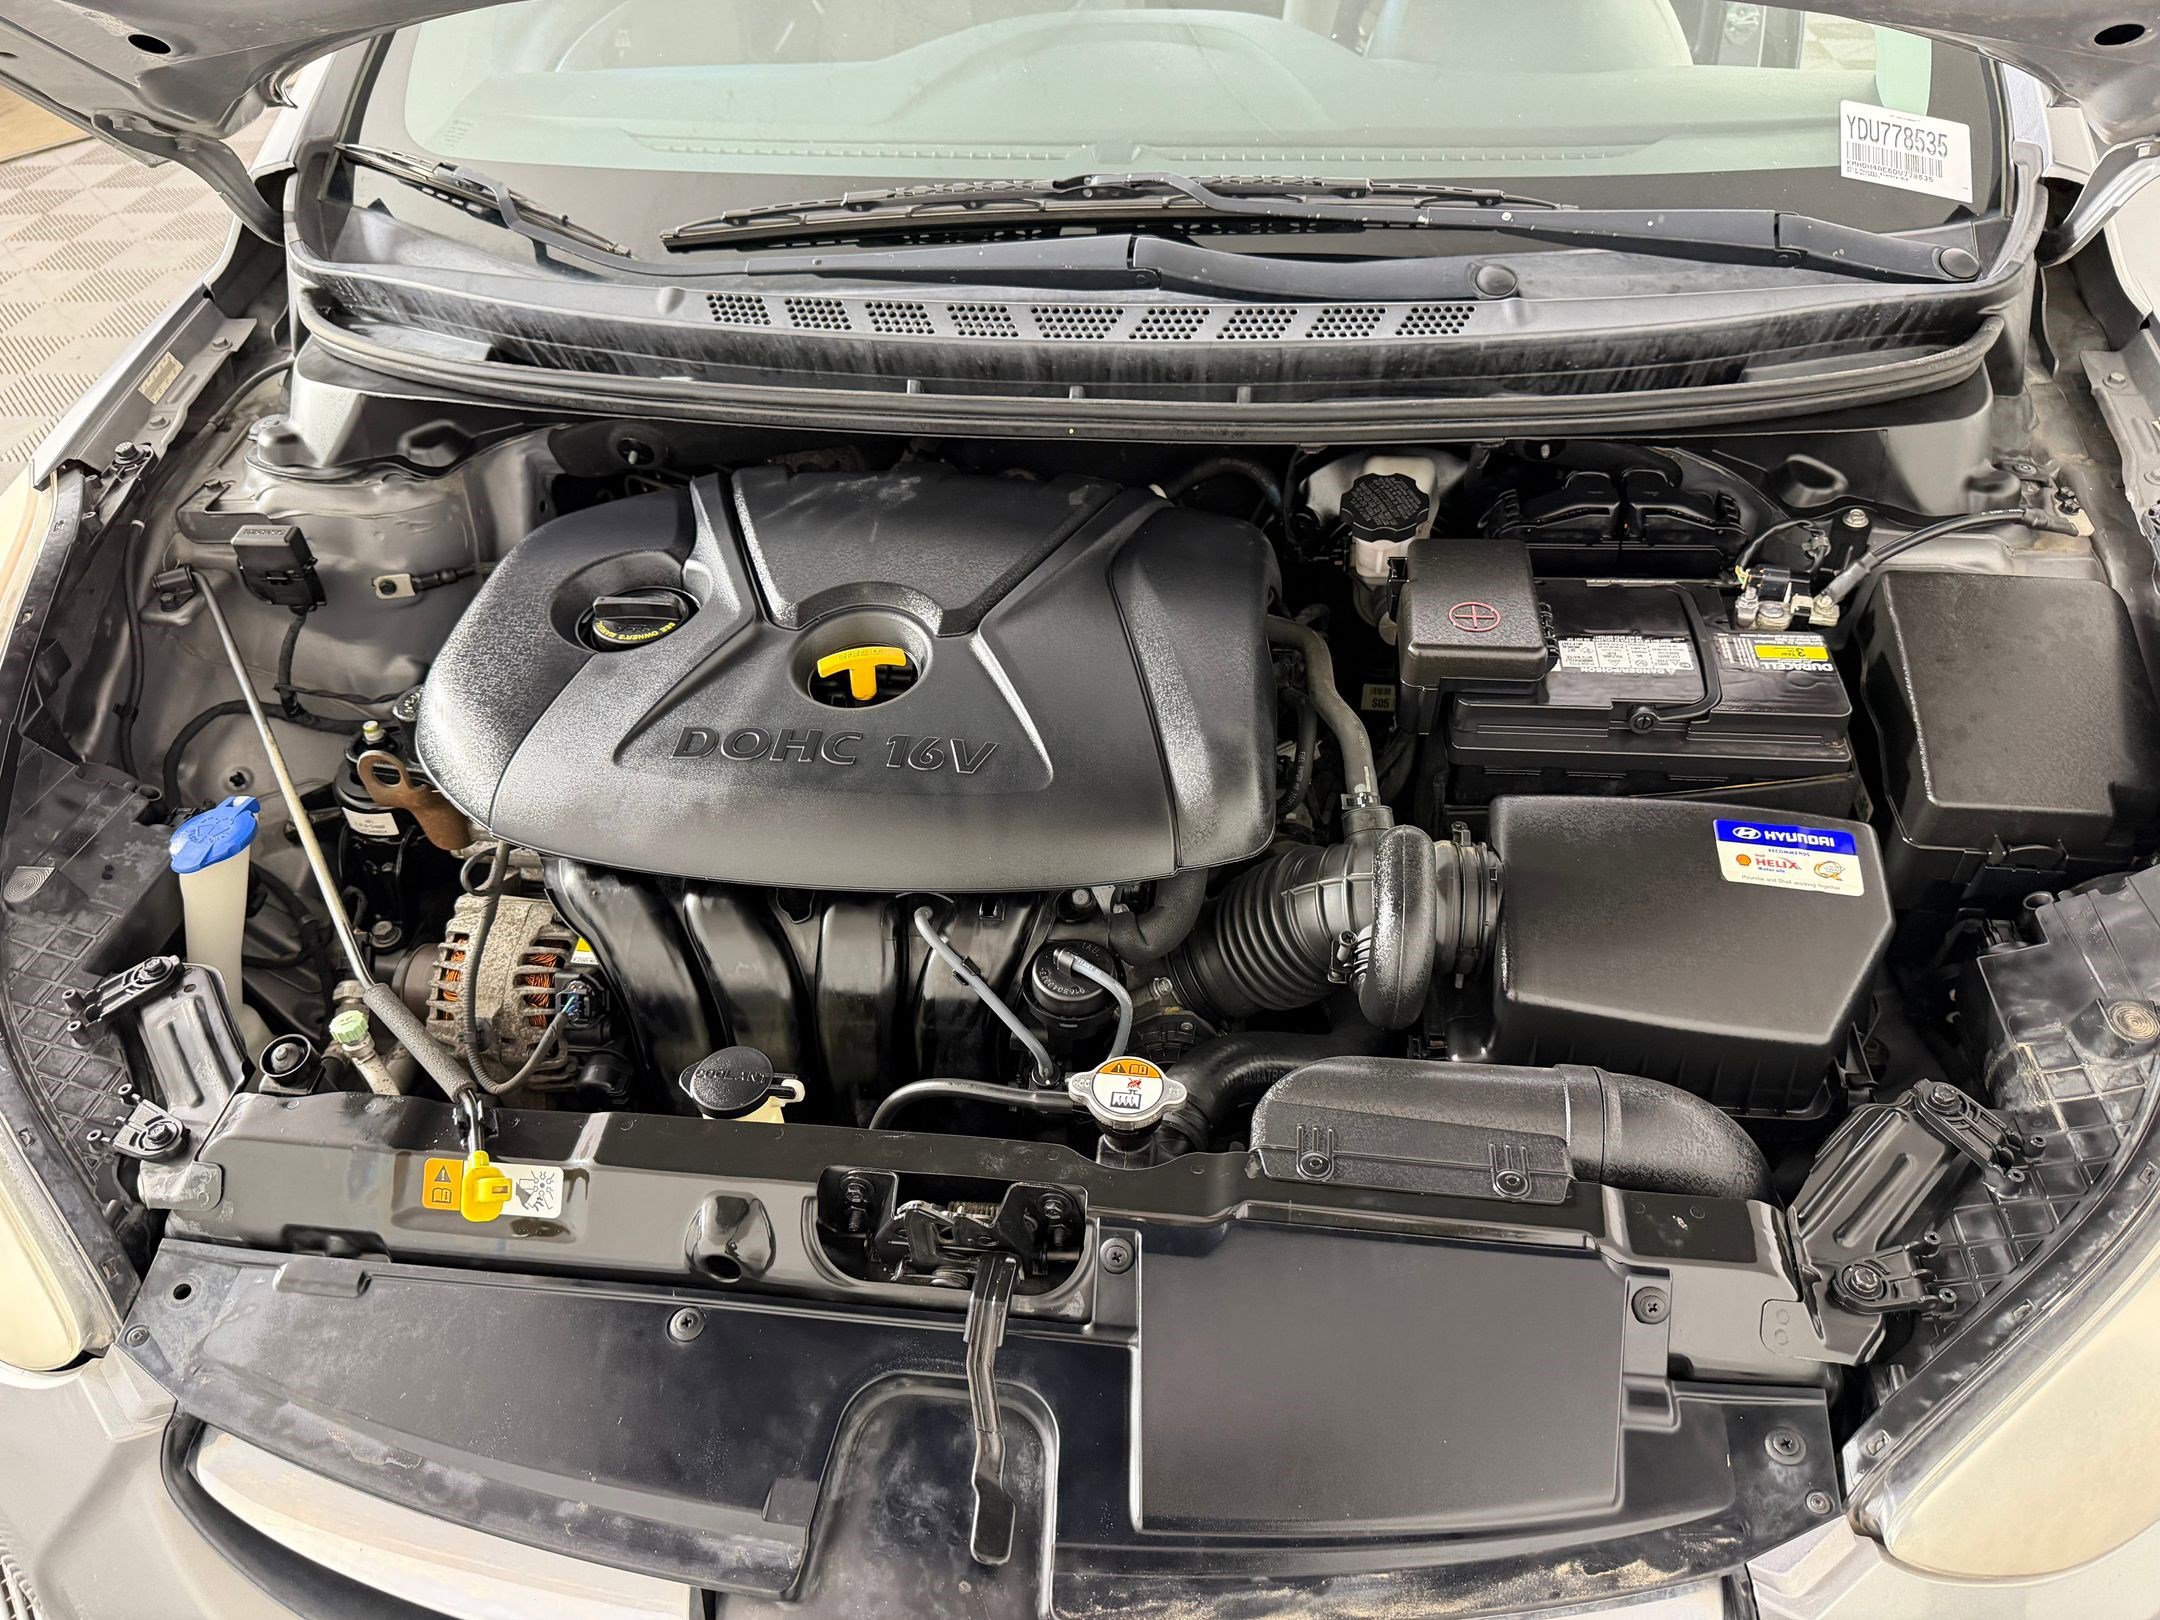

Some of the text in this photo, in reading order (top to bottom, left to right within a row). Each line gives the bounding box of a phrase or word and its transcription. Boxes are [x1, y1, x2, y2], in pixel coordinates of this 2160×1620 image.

[1846, 114, 1948, 158] YDU778535
[1761, 662, 1834, 671] DURACELL
[670, 727, 999, 774] DOHC 16V
[1764, 830, 1835, 847] HYUNDAI
[1768, 848, 1810, 857] RECOMMENDS
[1755, 858, 1801, 870] HELIX
[696, 1069, 766, 1083] COOLANT
